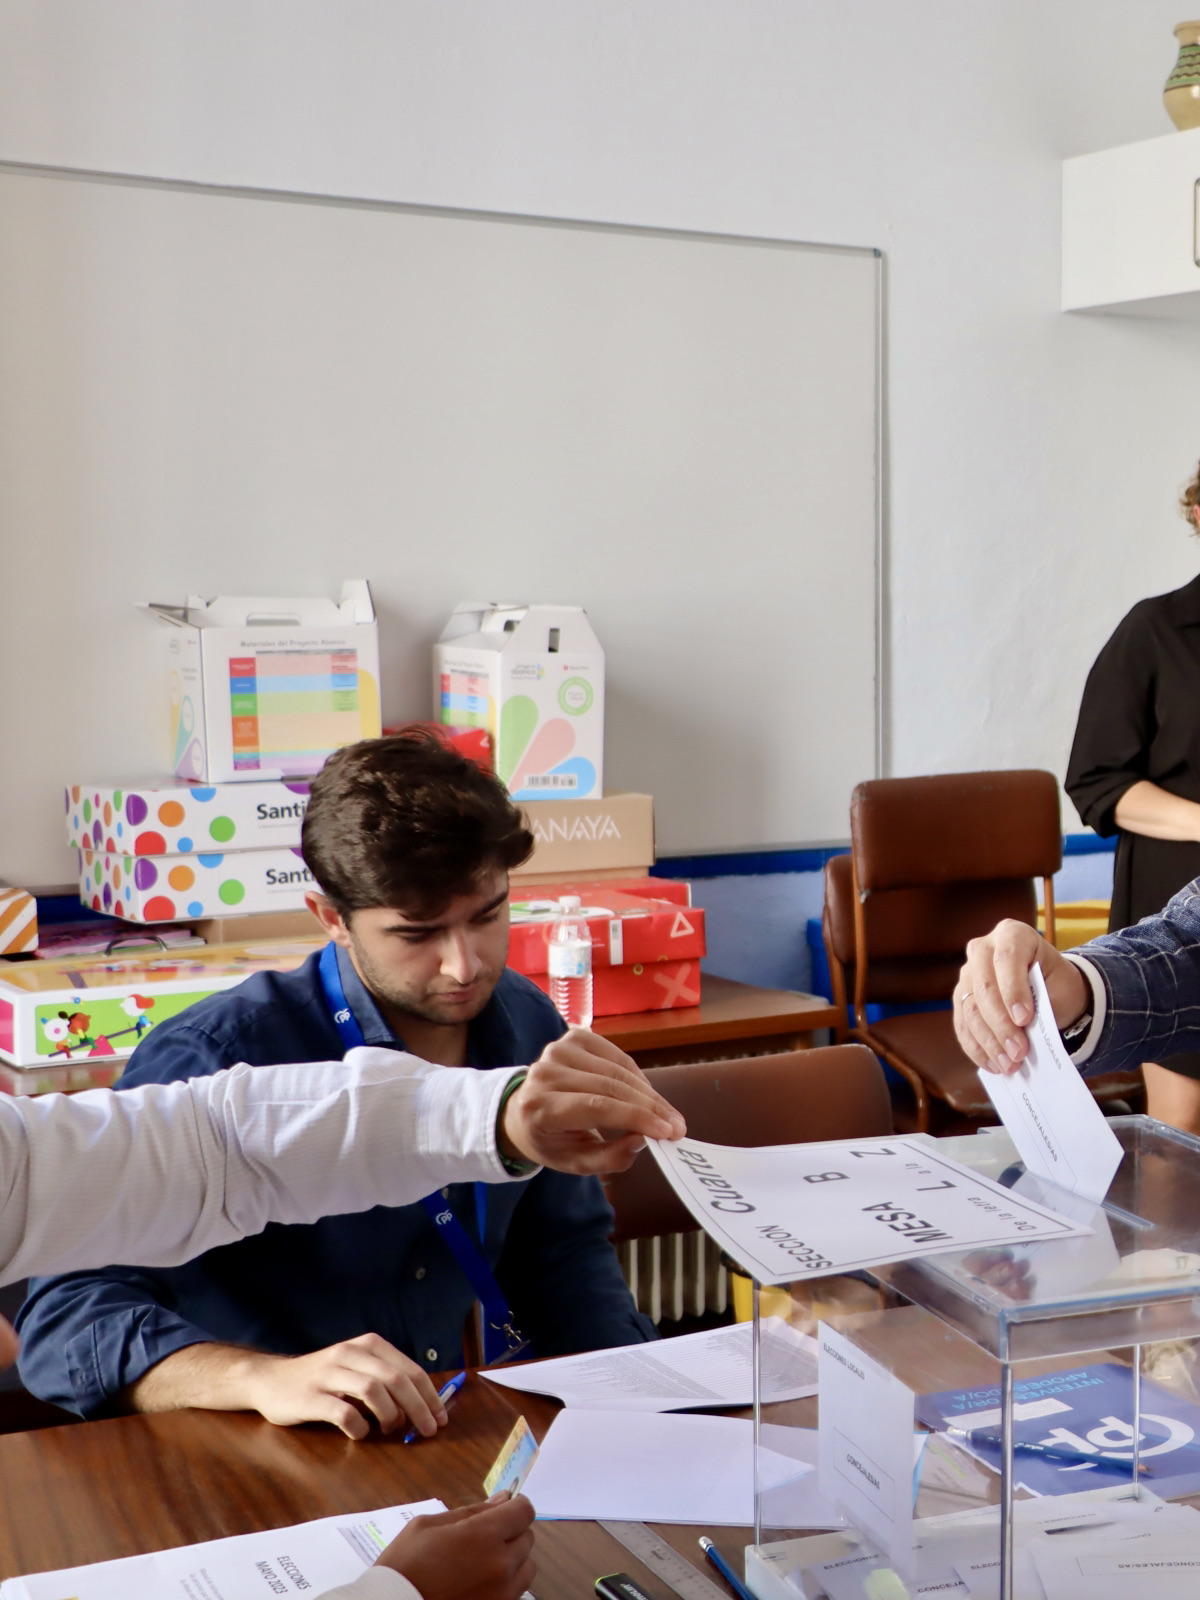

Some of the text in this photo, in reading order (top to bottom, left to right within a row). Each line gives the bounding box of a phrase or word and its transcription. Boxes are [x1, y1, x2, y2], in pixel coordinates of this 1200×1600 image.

[1021, 1091, 1059, 1164] CONCEJALES/AS
[849, 1147, 898, 1159] Z
[916, 1180, 959, 1192] L
[676, 1147, 834, 1269] SECCIÓN Cuarta
[802, 1171, 954, 1244] MESA B
[967, 1196, 998, 1213] letra
[998, 1208, 1017, 1221] la
[1013, 1220, 1038, 1232] De
[255, 1560, 289, 1595] MAYO 2023
[276, 1555, 312, 1590] ELECCIONES
